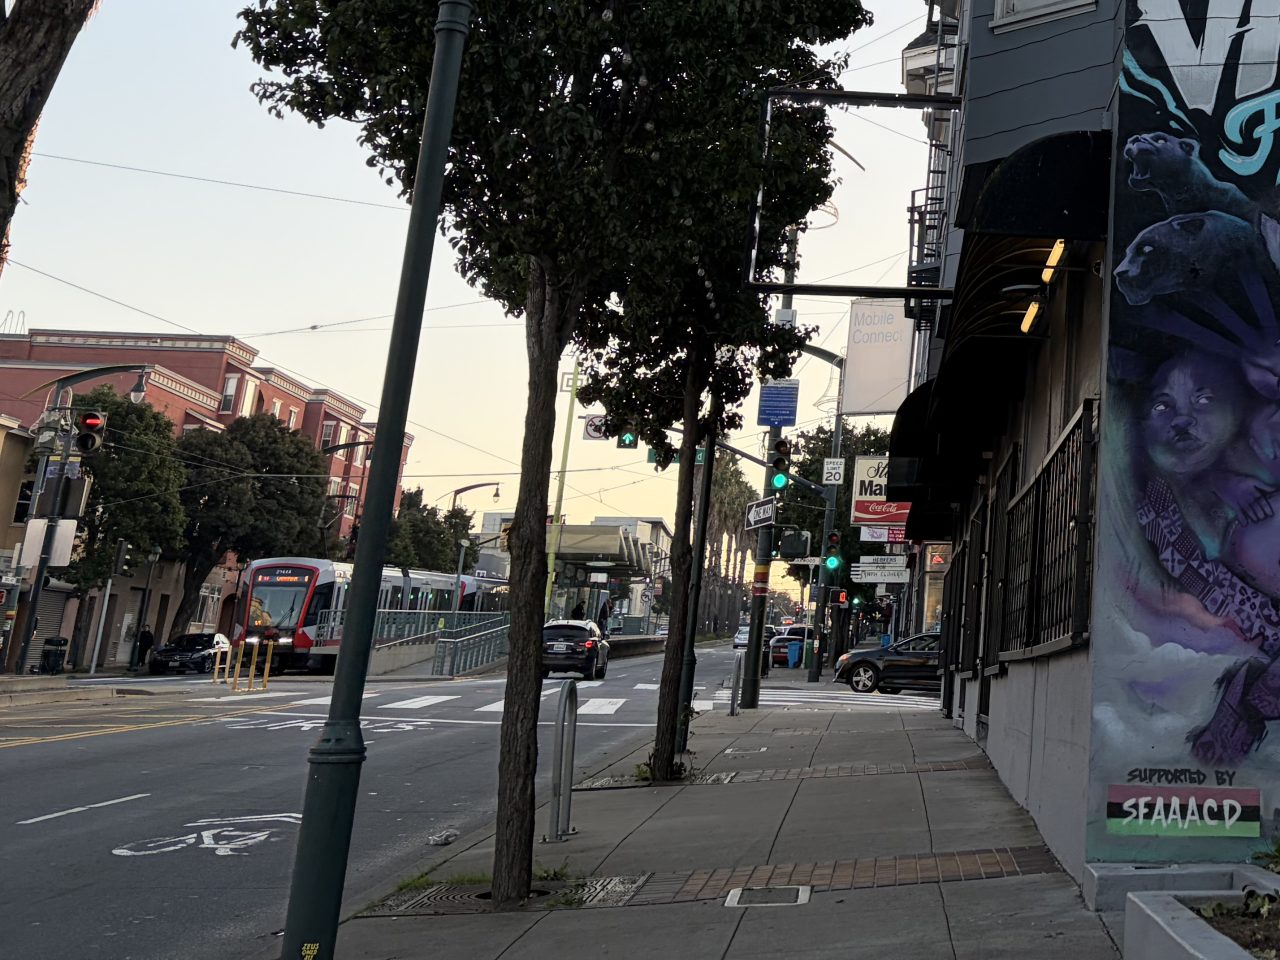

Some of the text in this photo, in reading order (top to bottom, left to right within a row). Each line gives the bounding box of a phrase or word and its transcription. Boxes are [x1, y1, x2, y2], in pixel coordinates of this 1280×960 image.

[825, 471, 842, 482] 20
[753, 504, 772, 519] ONE WAY
[1126, 768, 1236, 787] SUPPORTED BY
[1121, 796, 1242, 830] SFAAACD
